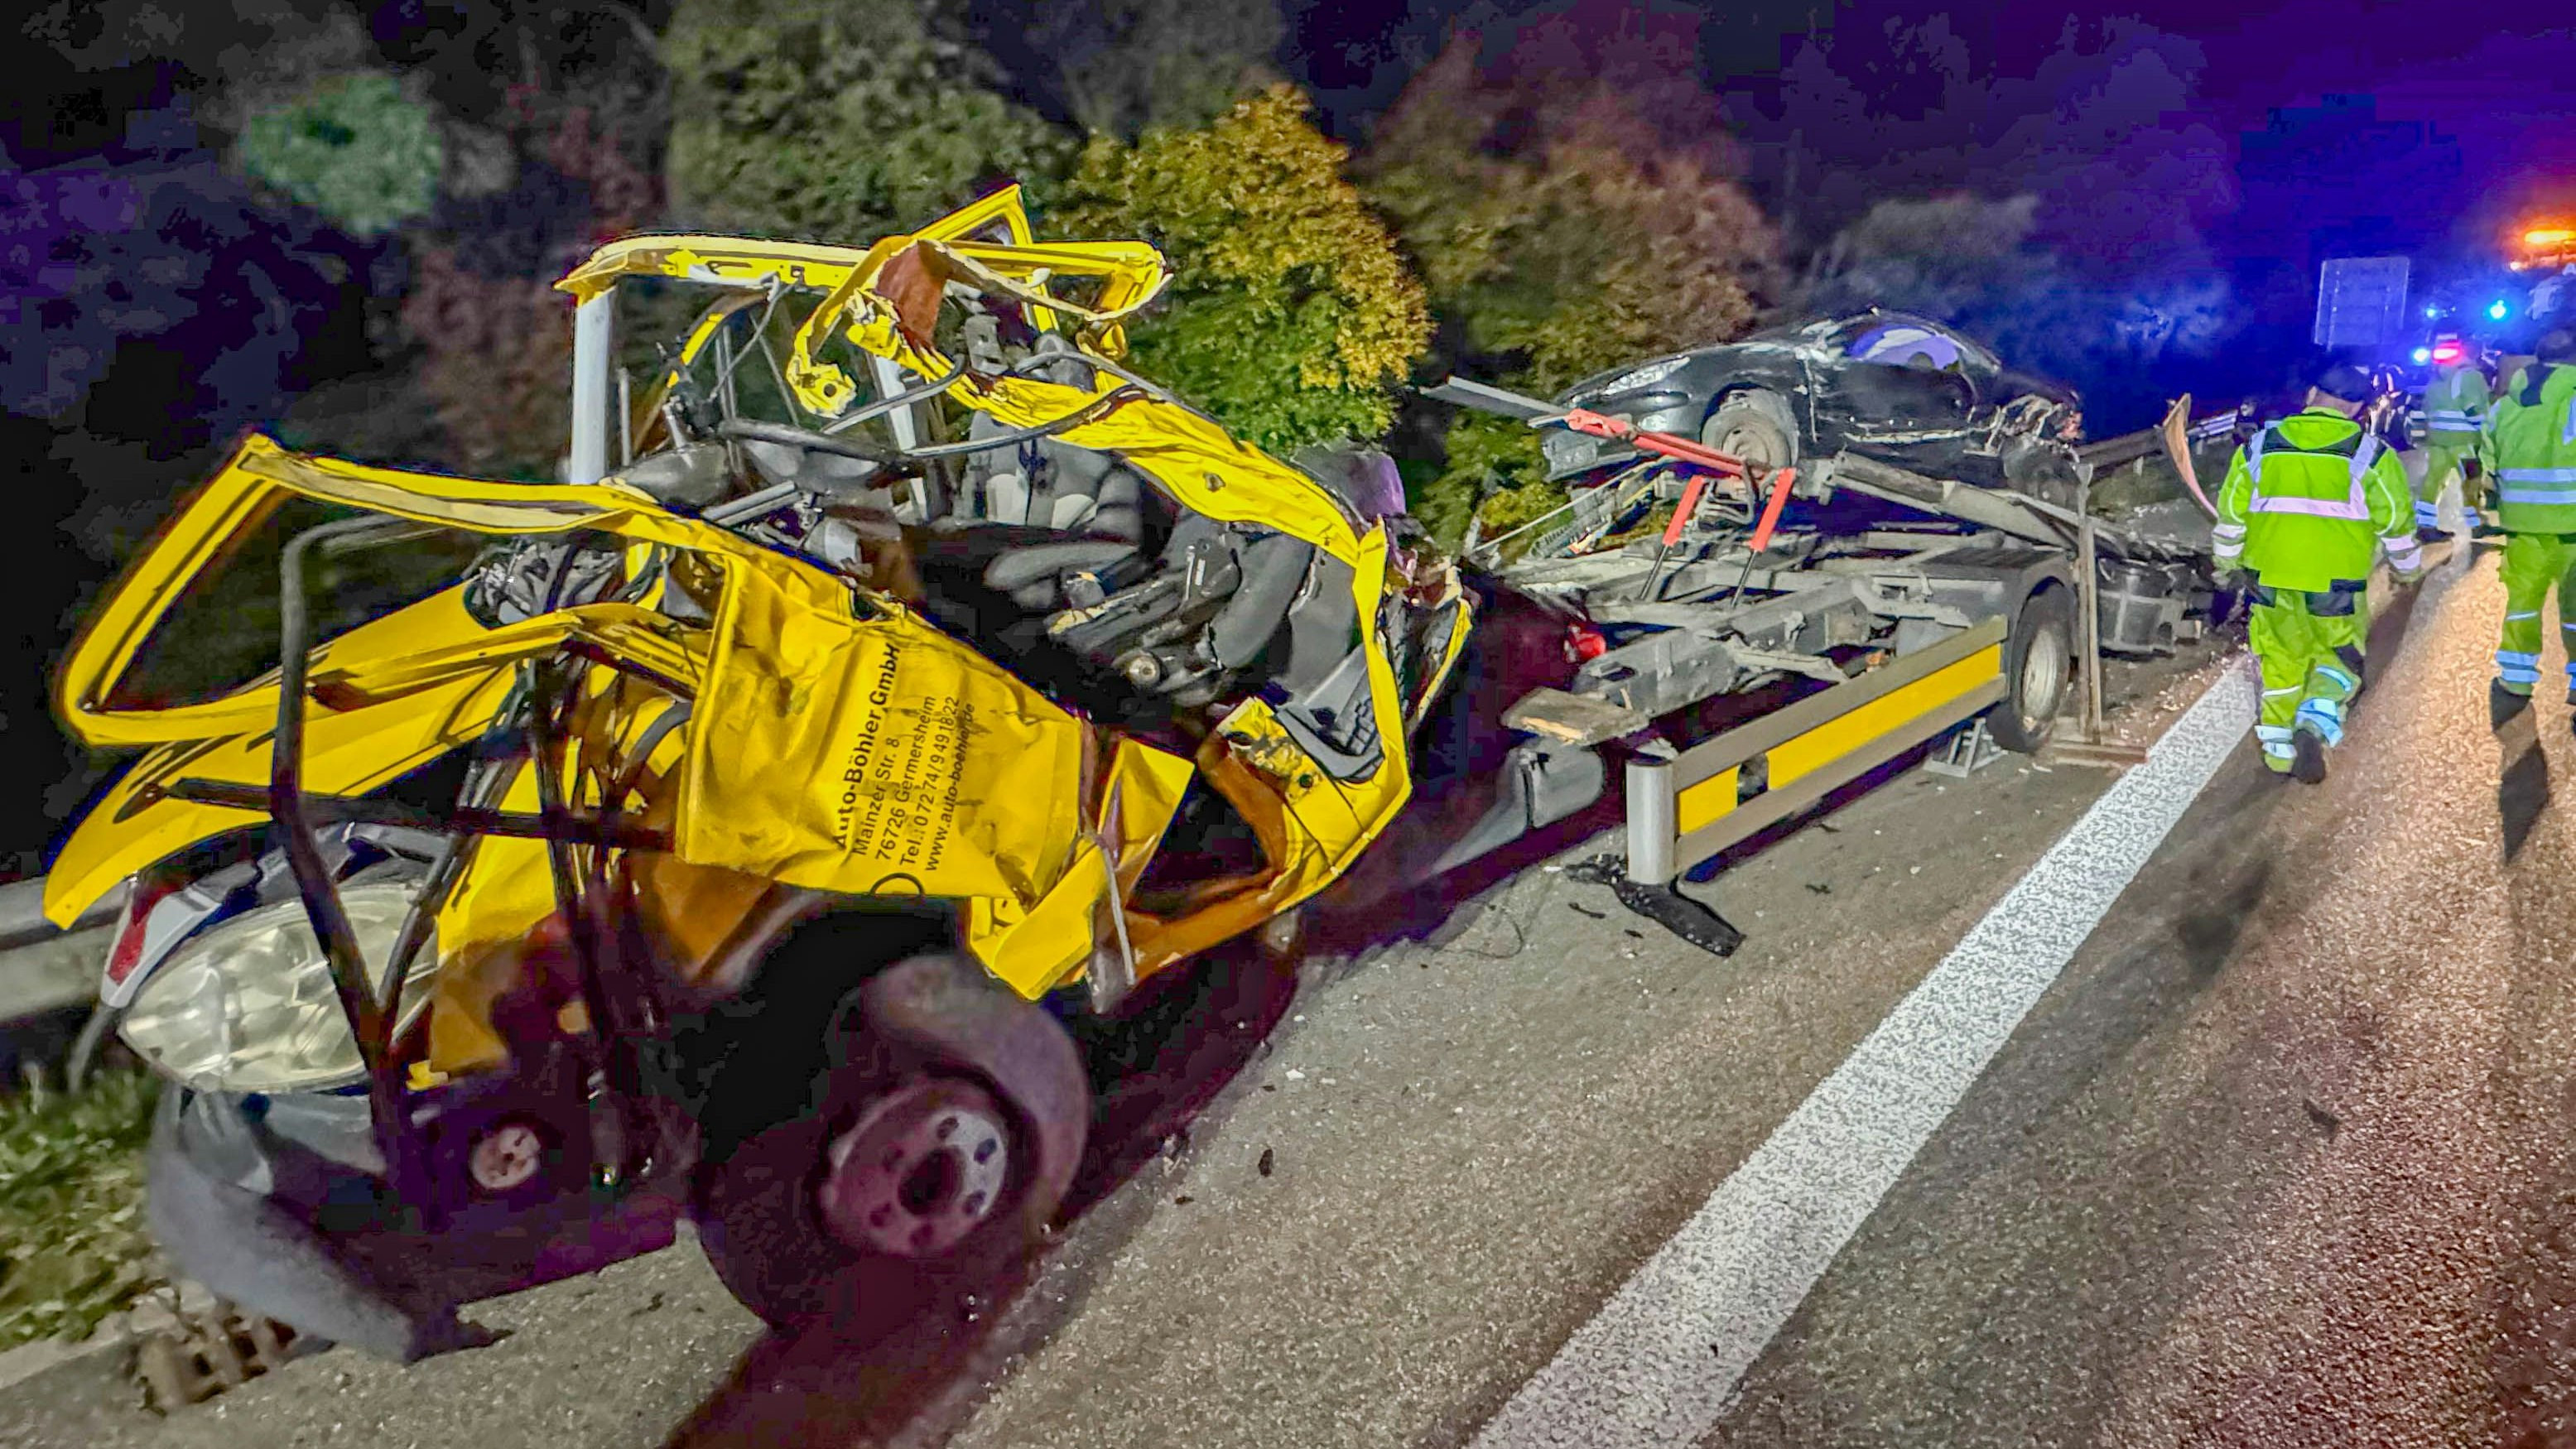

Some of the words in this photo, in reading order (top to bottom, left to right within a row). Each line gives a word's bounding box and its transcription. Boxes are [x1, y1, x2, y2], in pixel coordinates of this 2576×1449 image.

[869, 643, 900, 705] GmbH
[852, 785, 887, 855] Mainzer
[875, 754, 897, 780] Str.
[886, 738, 899, 748] 8
[875, 807, 906, 859] 76726
[894, 696, 936, 802] Germersheim
[925, 703, 975, 870] www.auto-boehlerde
